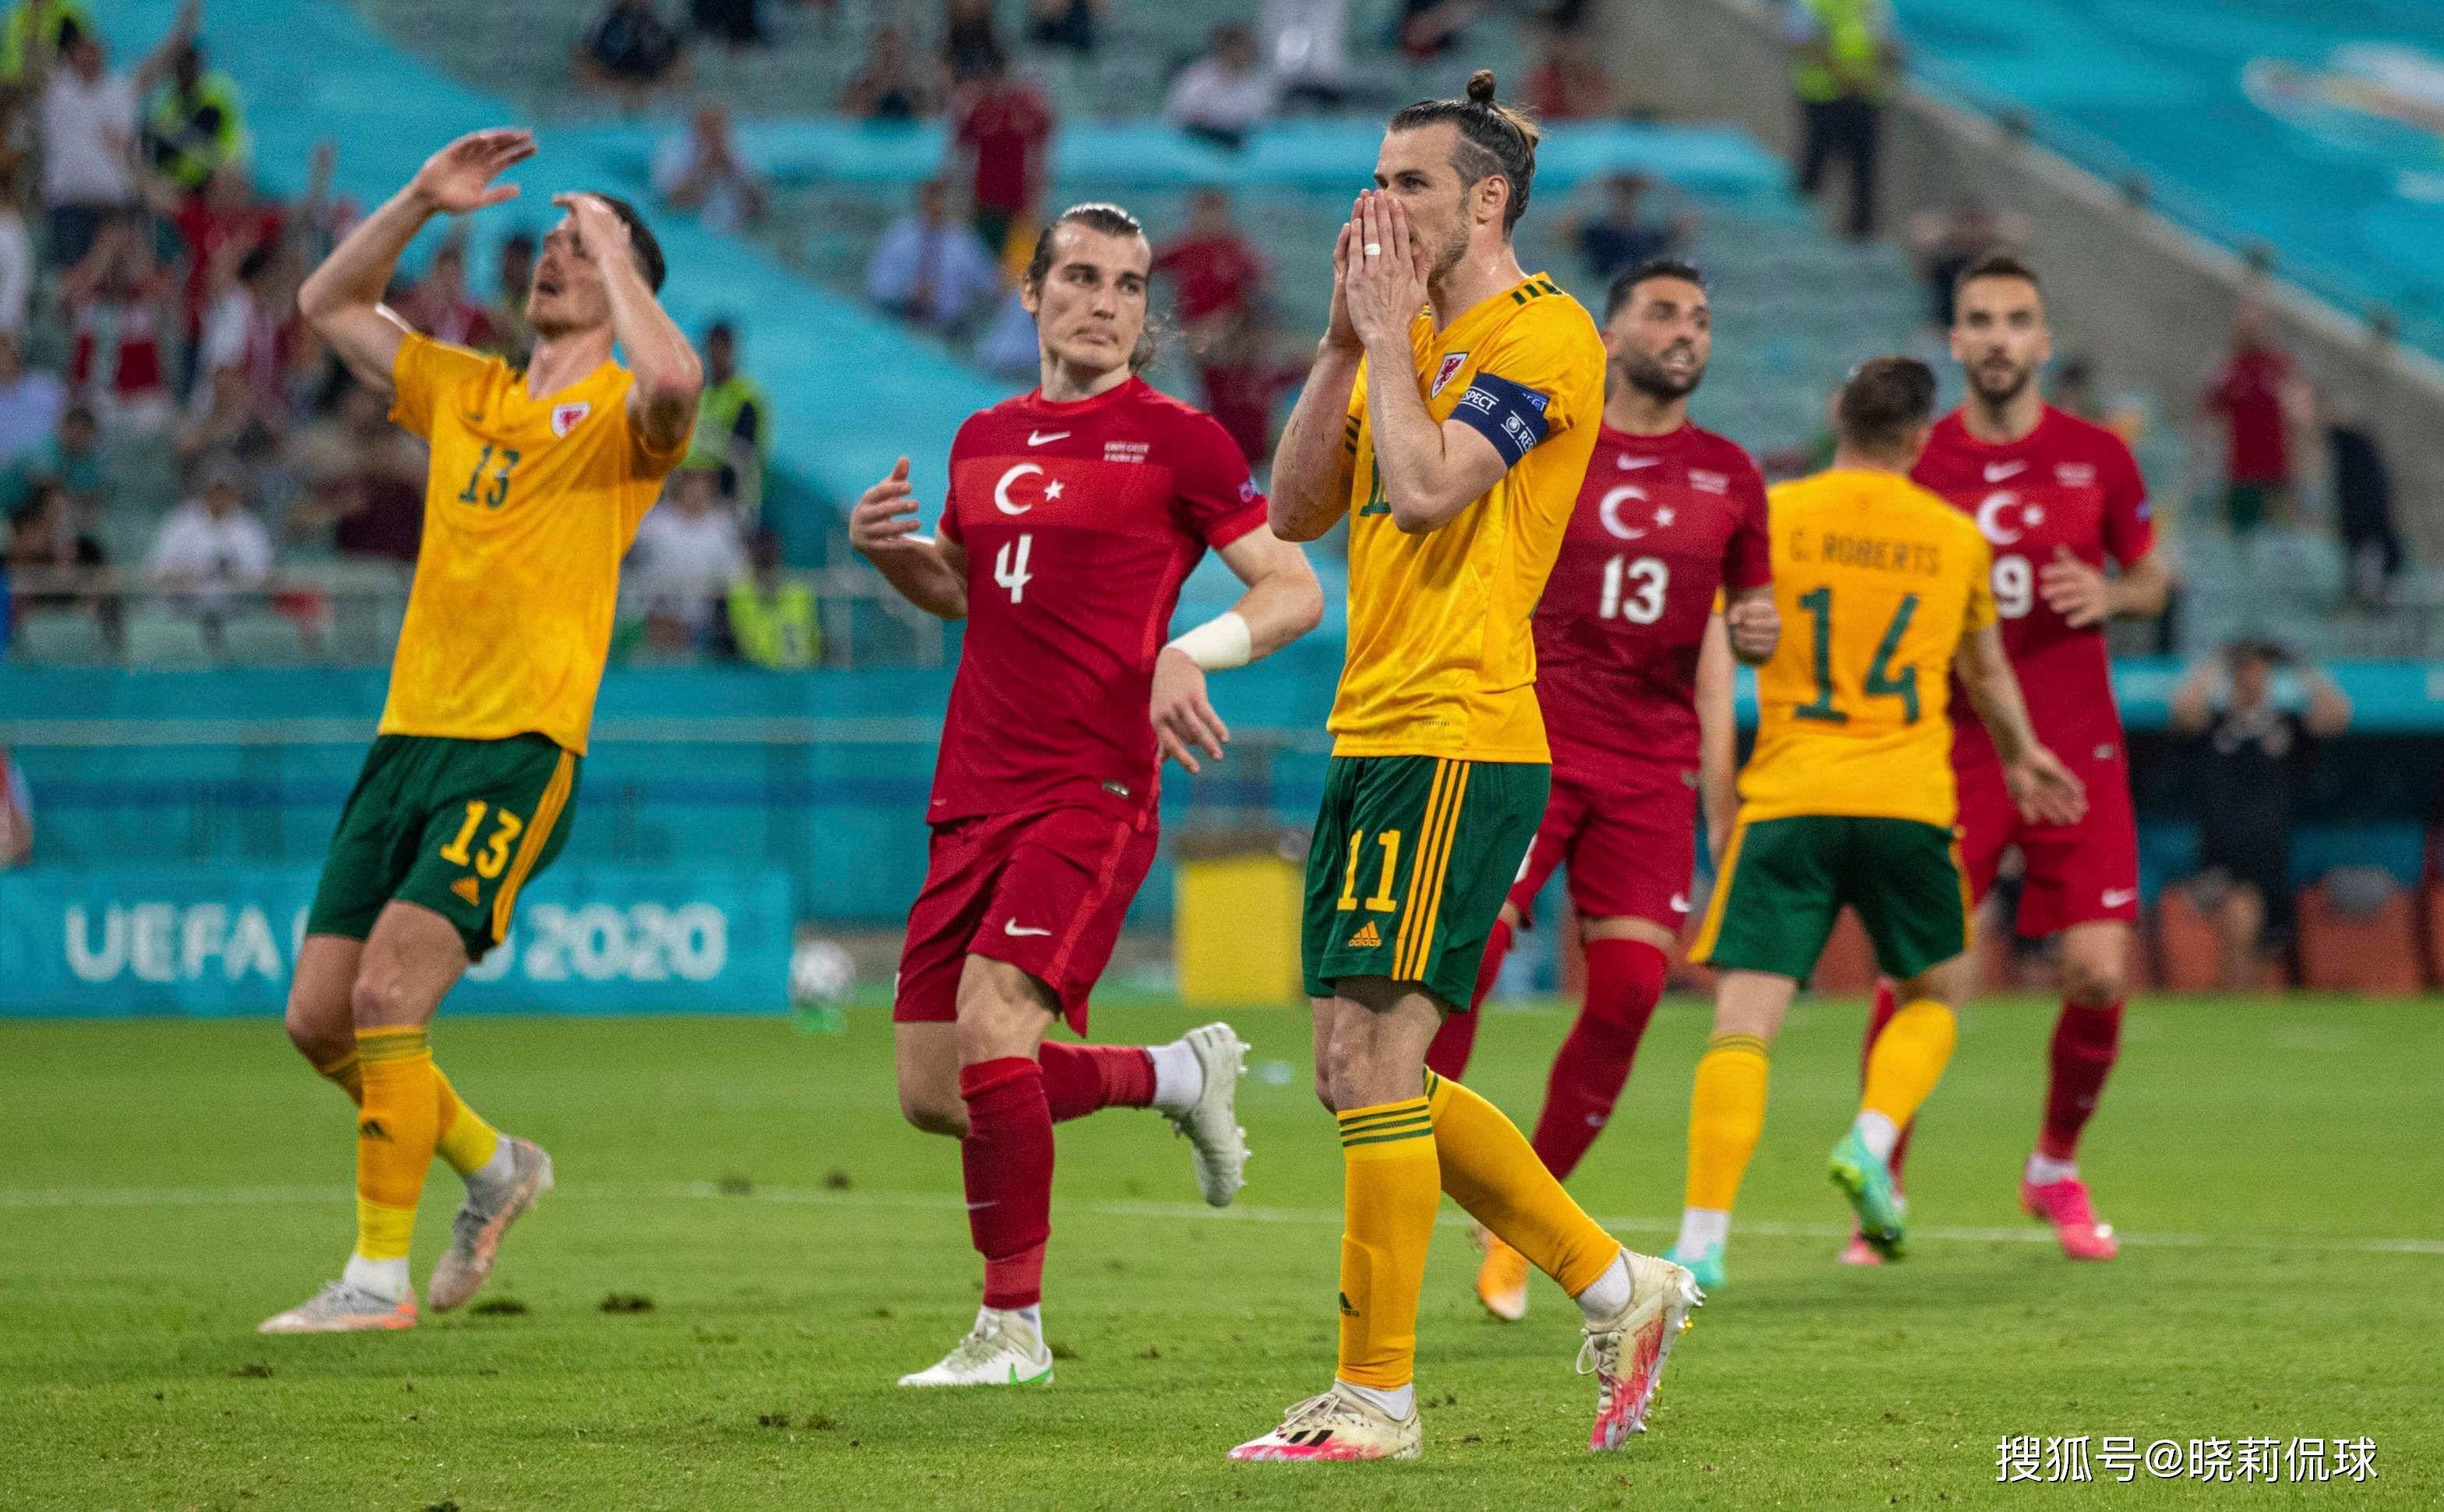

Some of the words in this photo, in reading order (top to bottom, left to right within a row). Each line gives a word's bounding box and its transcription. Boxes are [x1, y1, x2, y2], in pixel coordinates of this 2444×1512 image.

[459, 443, 520, 509] 13
[993, 534, 1033, 604] 4
[1599, 552, 1670, 625] 13
[1822, 533, 1940, 576] ROBERTS
[1991, 554, 2033, 619] 9
[1794, 587, 1920, 724] 14
[439, 800, 523, 879] 13
[1337, 829, 1401, 912] 11
[65, 903, 282, 982] UEFA
[525, 903, 728, 982] 2020
